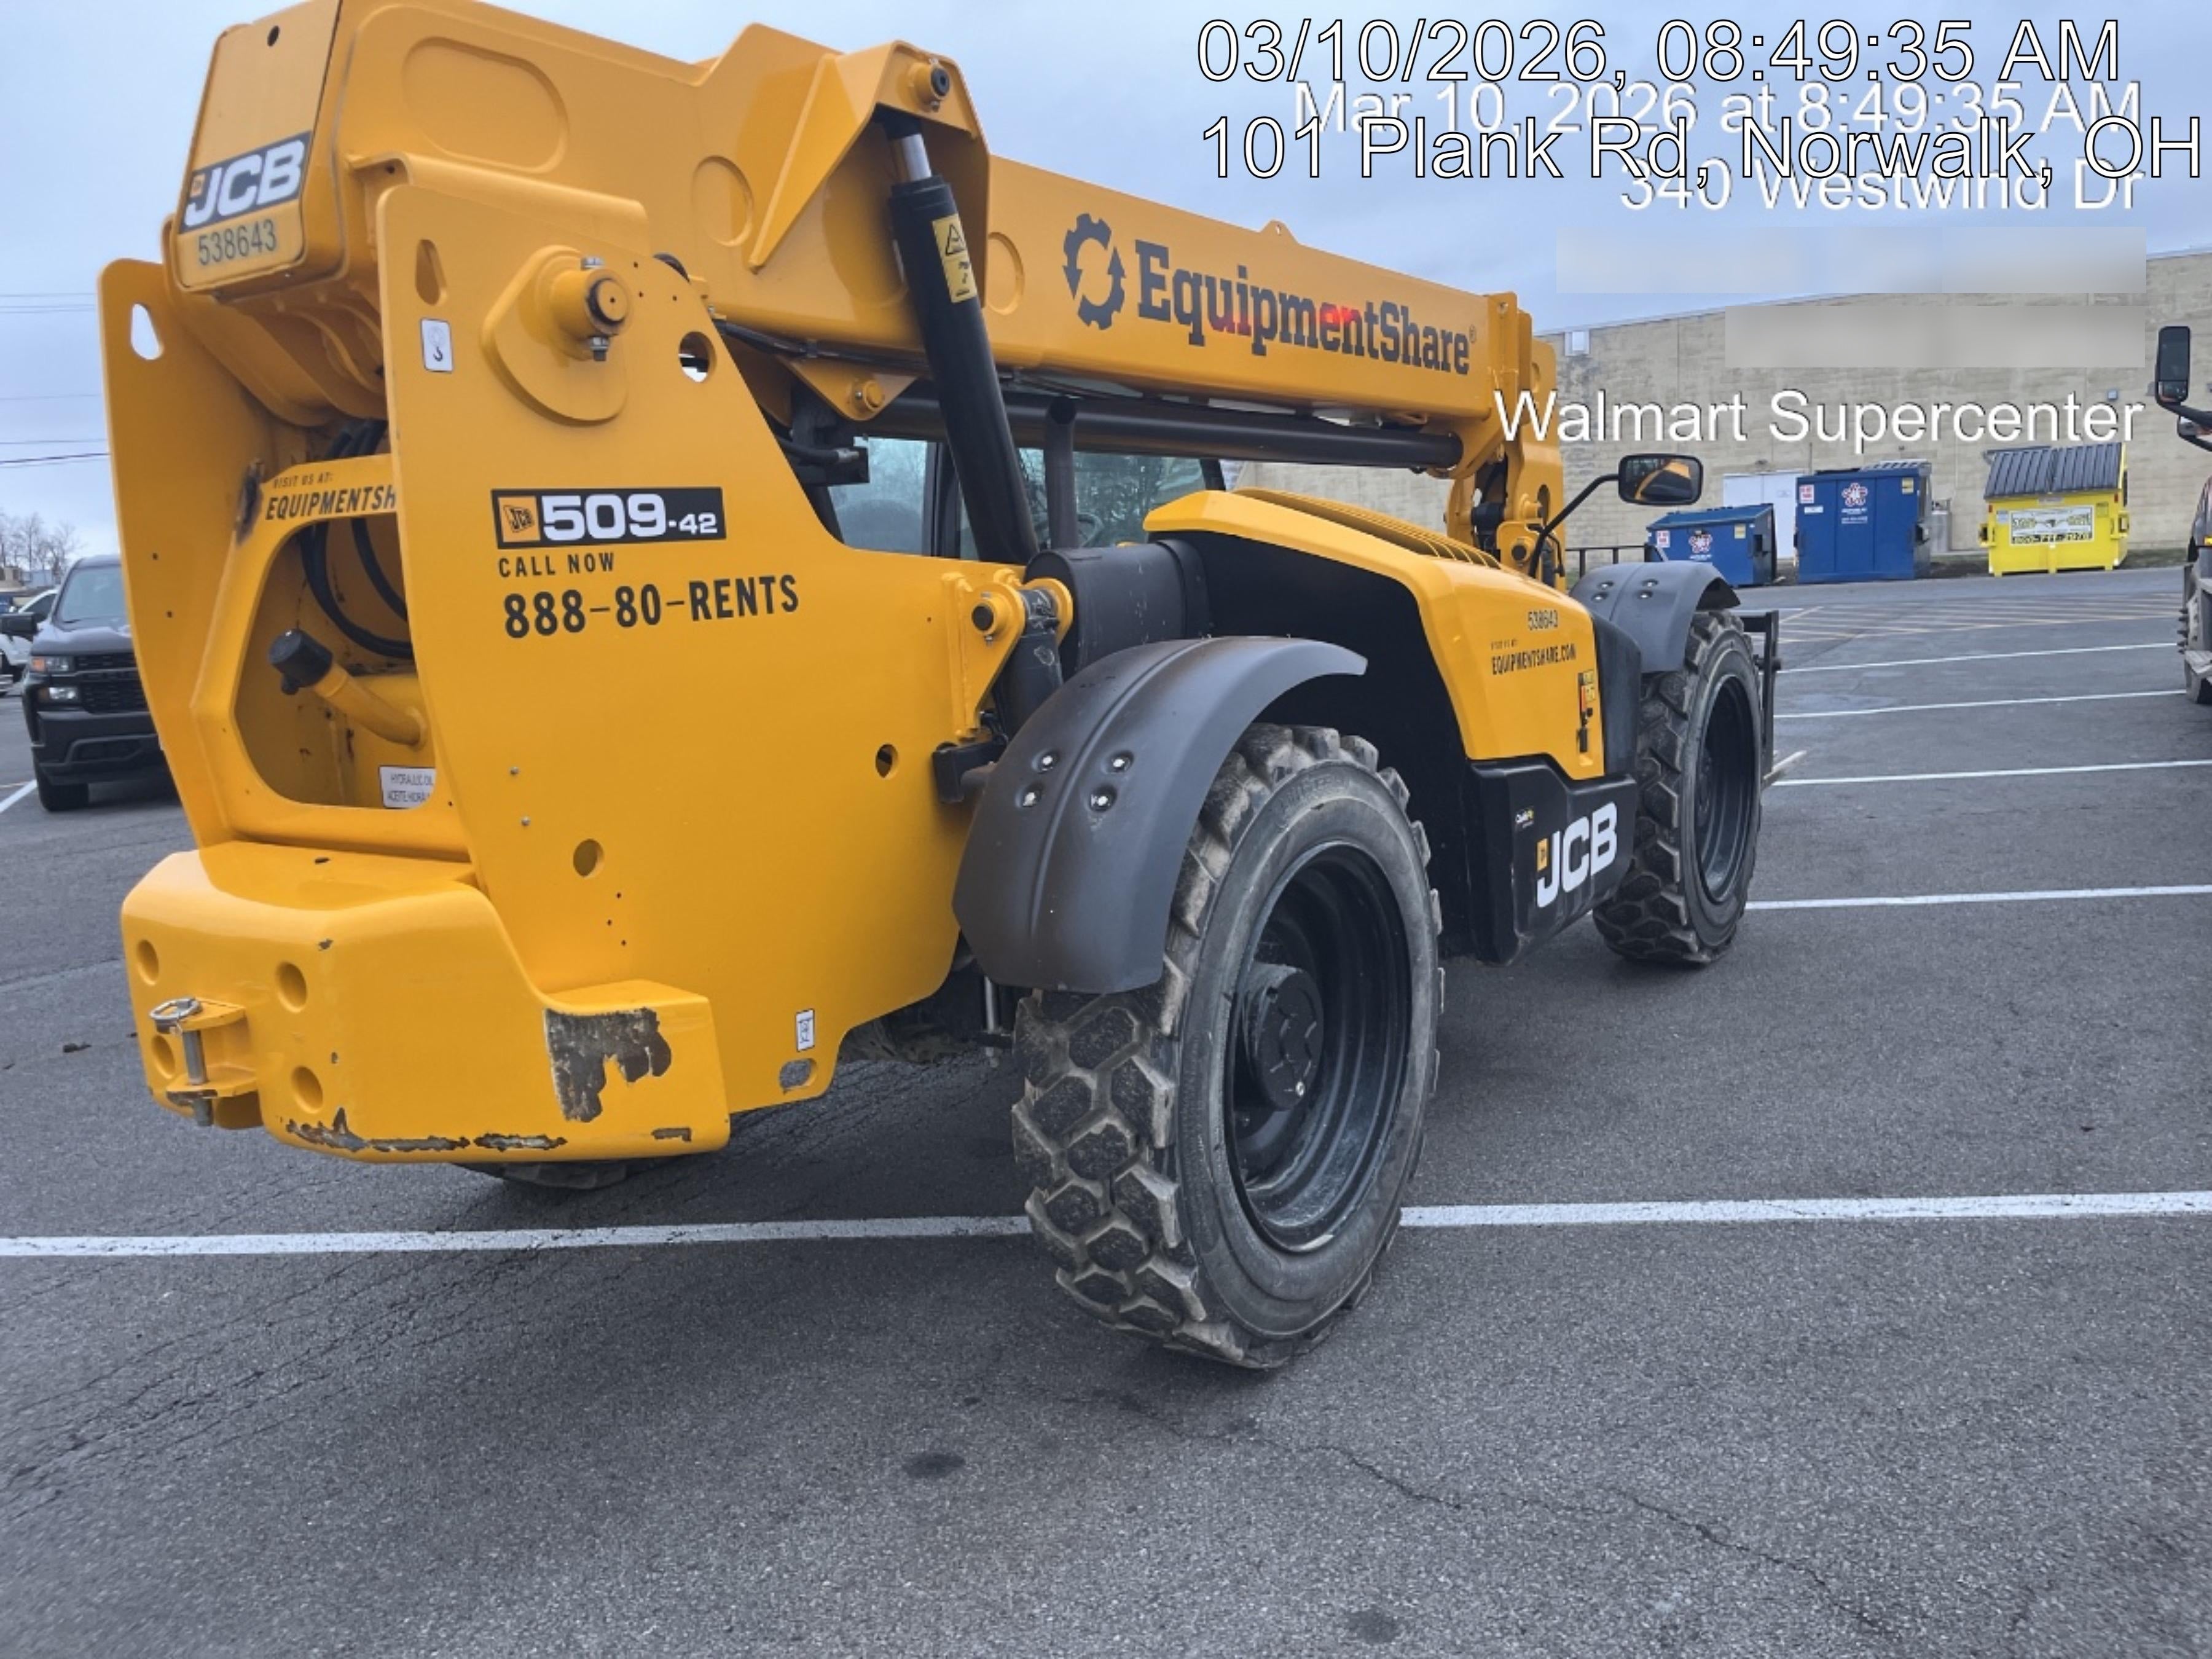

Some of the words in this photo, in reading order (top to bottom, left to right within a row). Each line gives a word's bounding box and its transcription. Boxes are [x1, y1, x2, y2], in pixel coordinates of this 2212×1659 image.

[185, 139, 305, 227] JCB
[198, 219, 276, 266] 538643
[1134, 239, 1470, 375] EquipmentShare
[273, 476, 297, 489] VISIT
[302, 474, 315, 485] US
[498, 555, 555, 578] CALL
[568, 552, 614, 574] NOW
[503, 575, 799, 638] 888-80-RENTS
[1536, 802, 1618, 909] JCB
